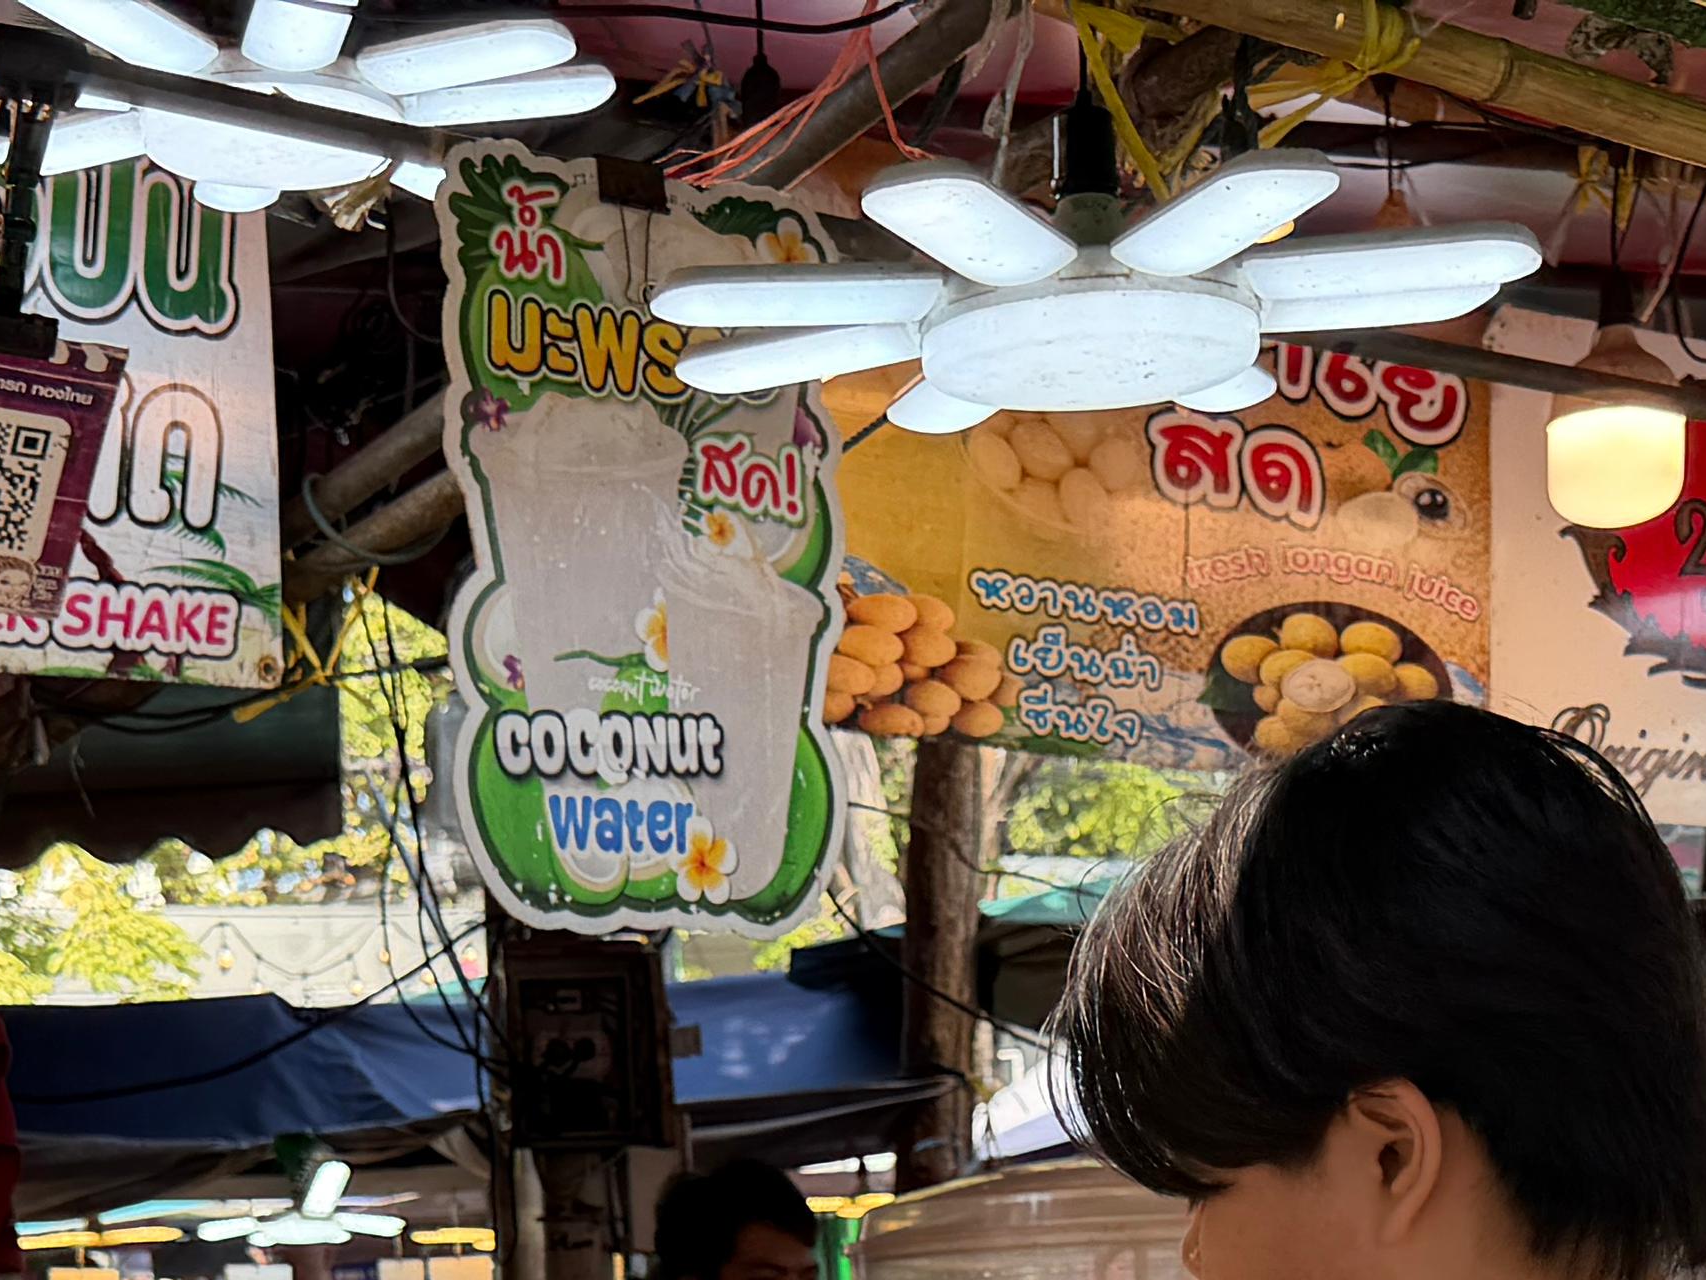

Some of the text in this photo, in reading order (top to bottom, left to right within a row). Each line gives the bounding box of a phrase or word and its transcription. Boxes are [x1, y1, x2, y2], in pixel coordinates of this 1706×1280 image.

[495, 183, 564, 280] น้ำ
[700, 442, 799, 516] สด!
[1158, 423, 1315, 515] สด
[62, 593, 232, 647] SHAKE
[973, 572, 1198, 634] หวานหอม
[1406, 565, 1479, 622] juice
